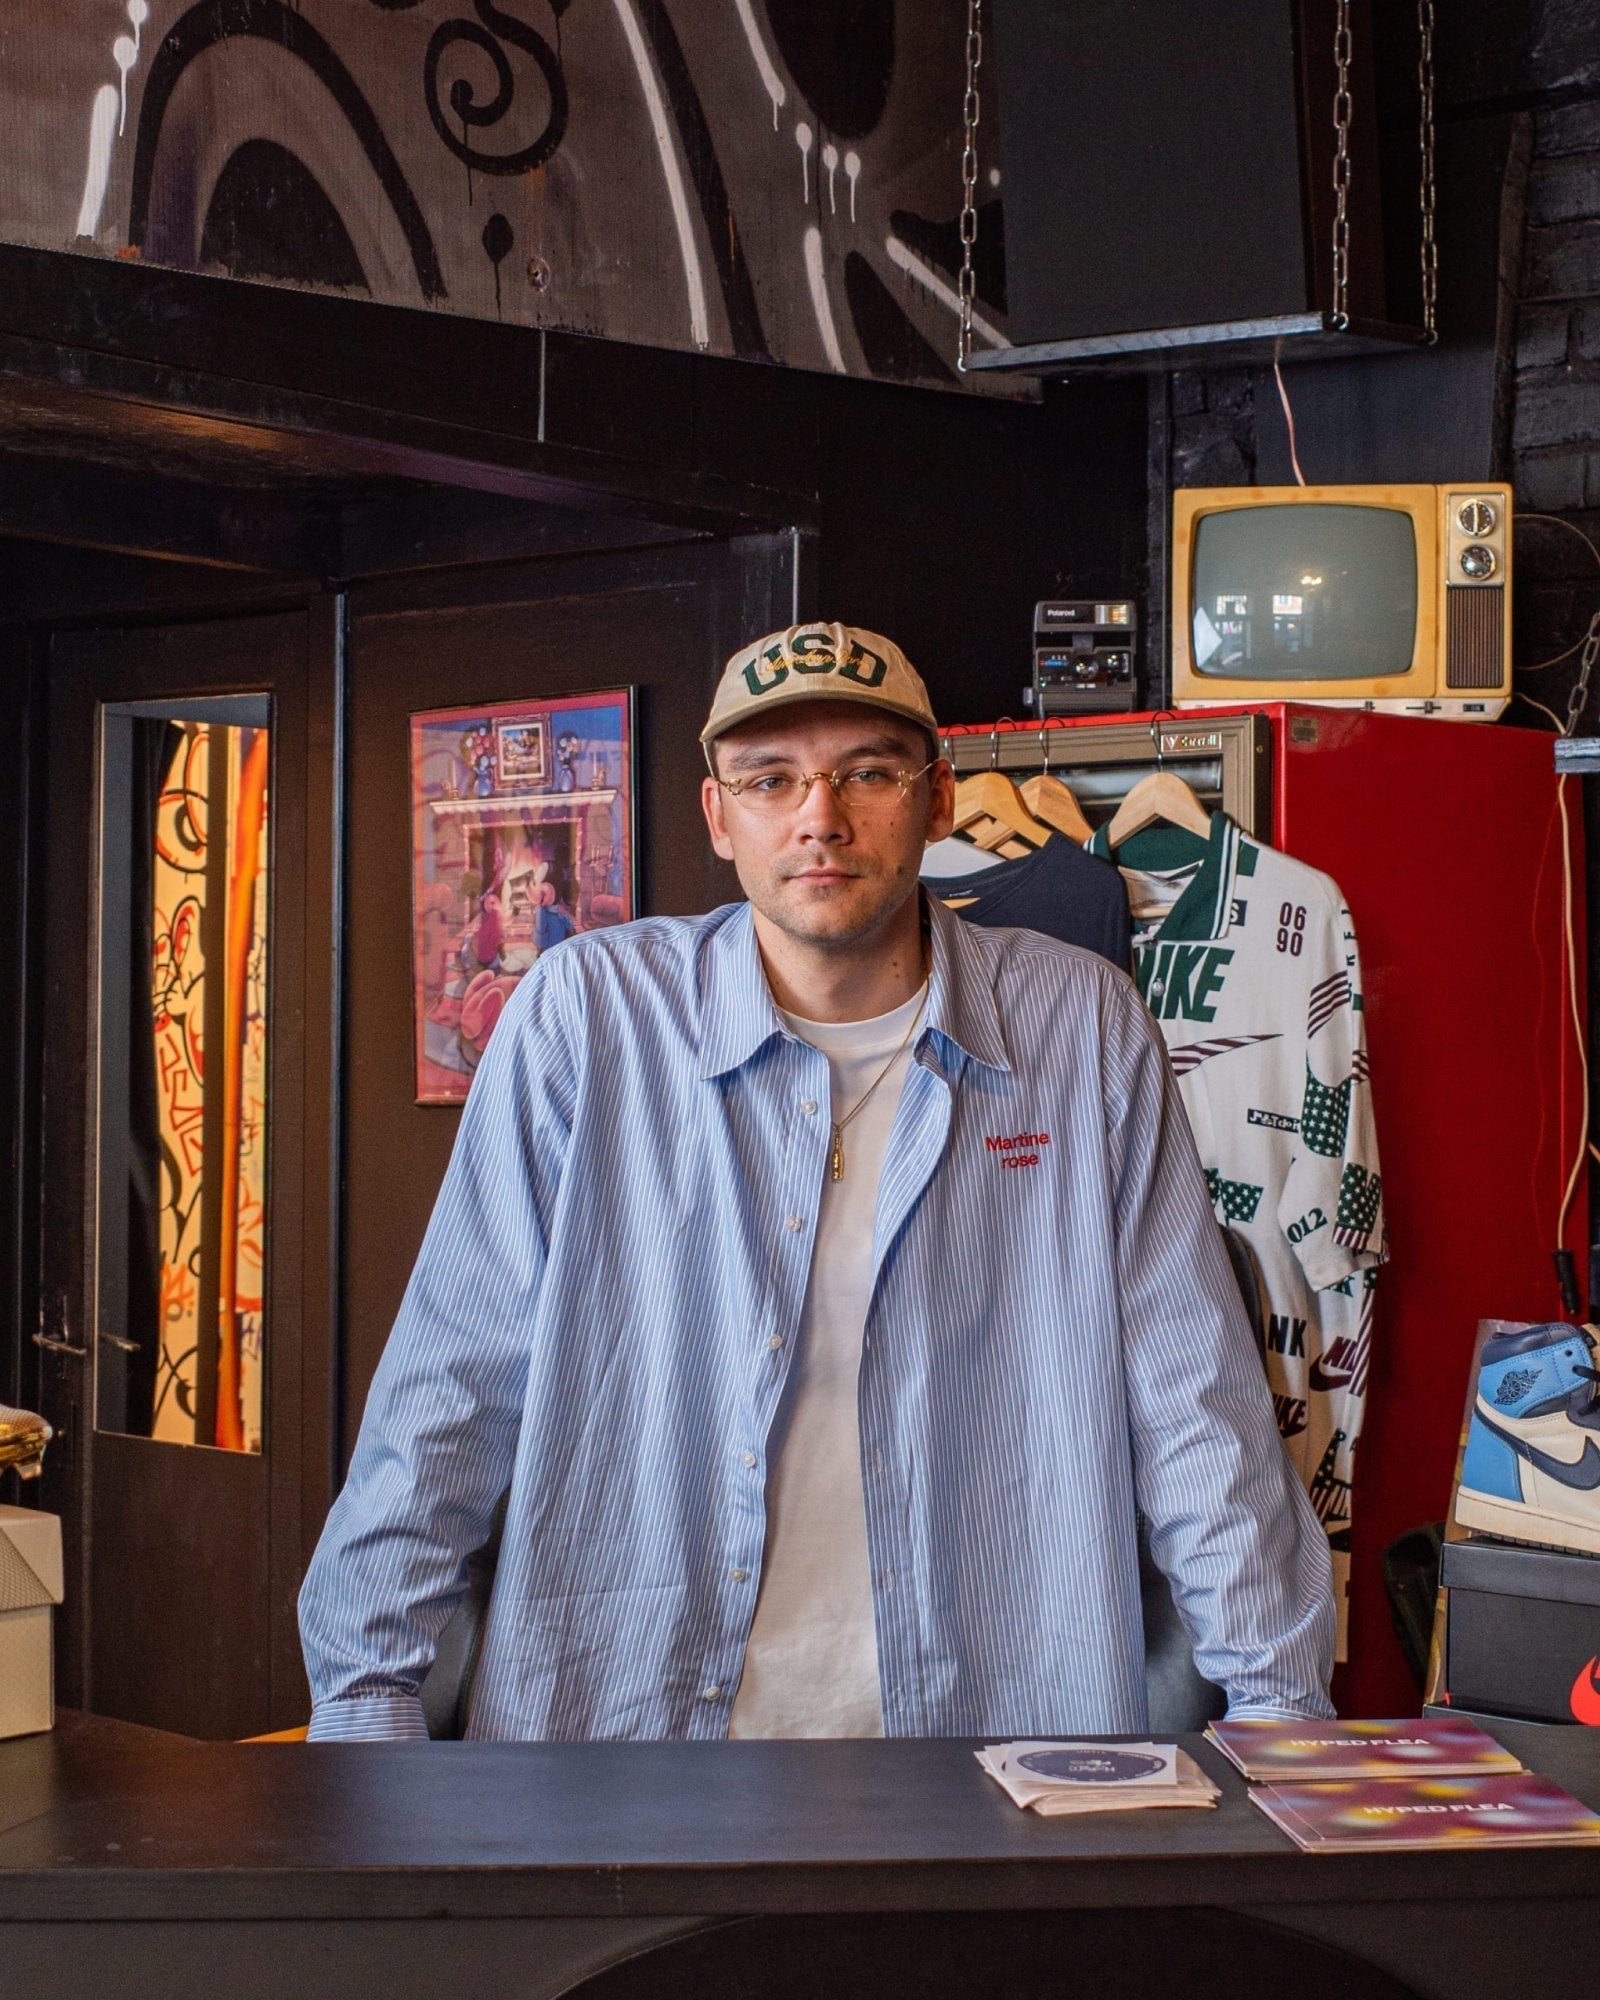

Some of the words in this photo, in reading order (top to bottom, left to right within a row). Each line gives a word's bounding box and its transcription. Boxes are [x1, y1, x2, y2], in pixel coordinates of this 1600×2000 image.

[1047, 609, 1076, 617] Polaroid
[742, 634, 888, 695] USD
[1280, 902, 1307, 931] 06
[1276, 928, 1303, 957] 90
[986, 1132, 1049, 1152] Martine
[1002, 1154, 1038, 1169] rose
[1290, 1739, 1368, 1747] HYPED
[1369, 1738, 1430, 1746] FLEA
[1363, 1805, 1448, 1814] HYPED
[1449, 1803, 1515, 1812] FLEA
